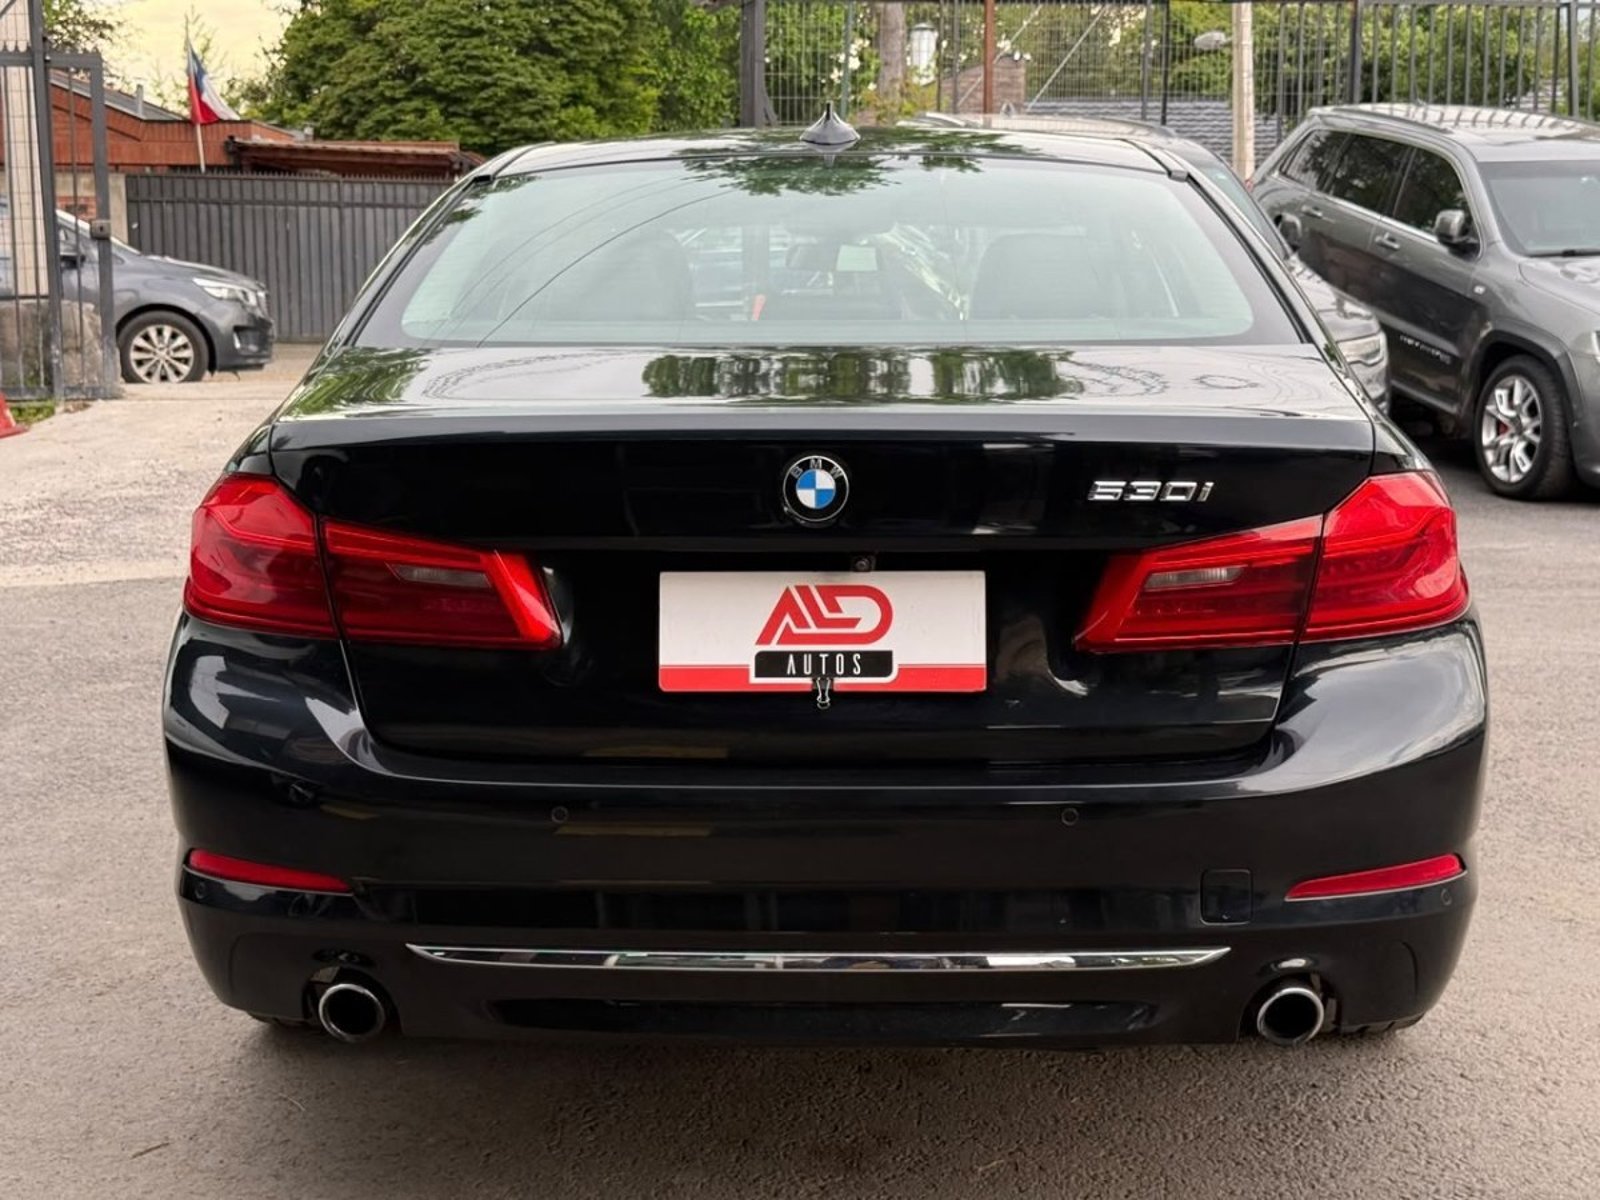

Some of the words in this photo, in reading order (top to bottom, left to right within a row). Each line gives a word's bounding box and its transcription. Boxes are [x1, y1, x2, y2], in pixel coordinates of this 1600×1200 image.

[790, 458, 844, 479] BMW
[1088, 480, 1215, 502] 530i
[786, 653, 862, 676] AUTOS
